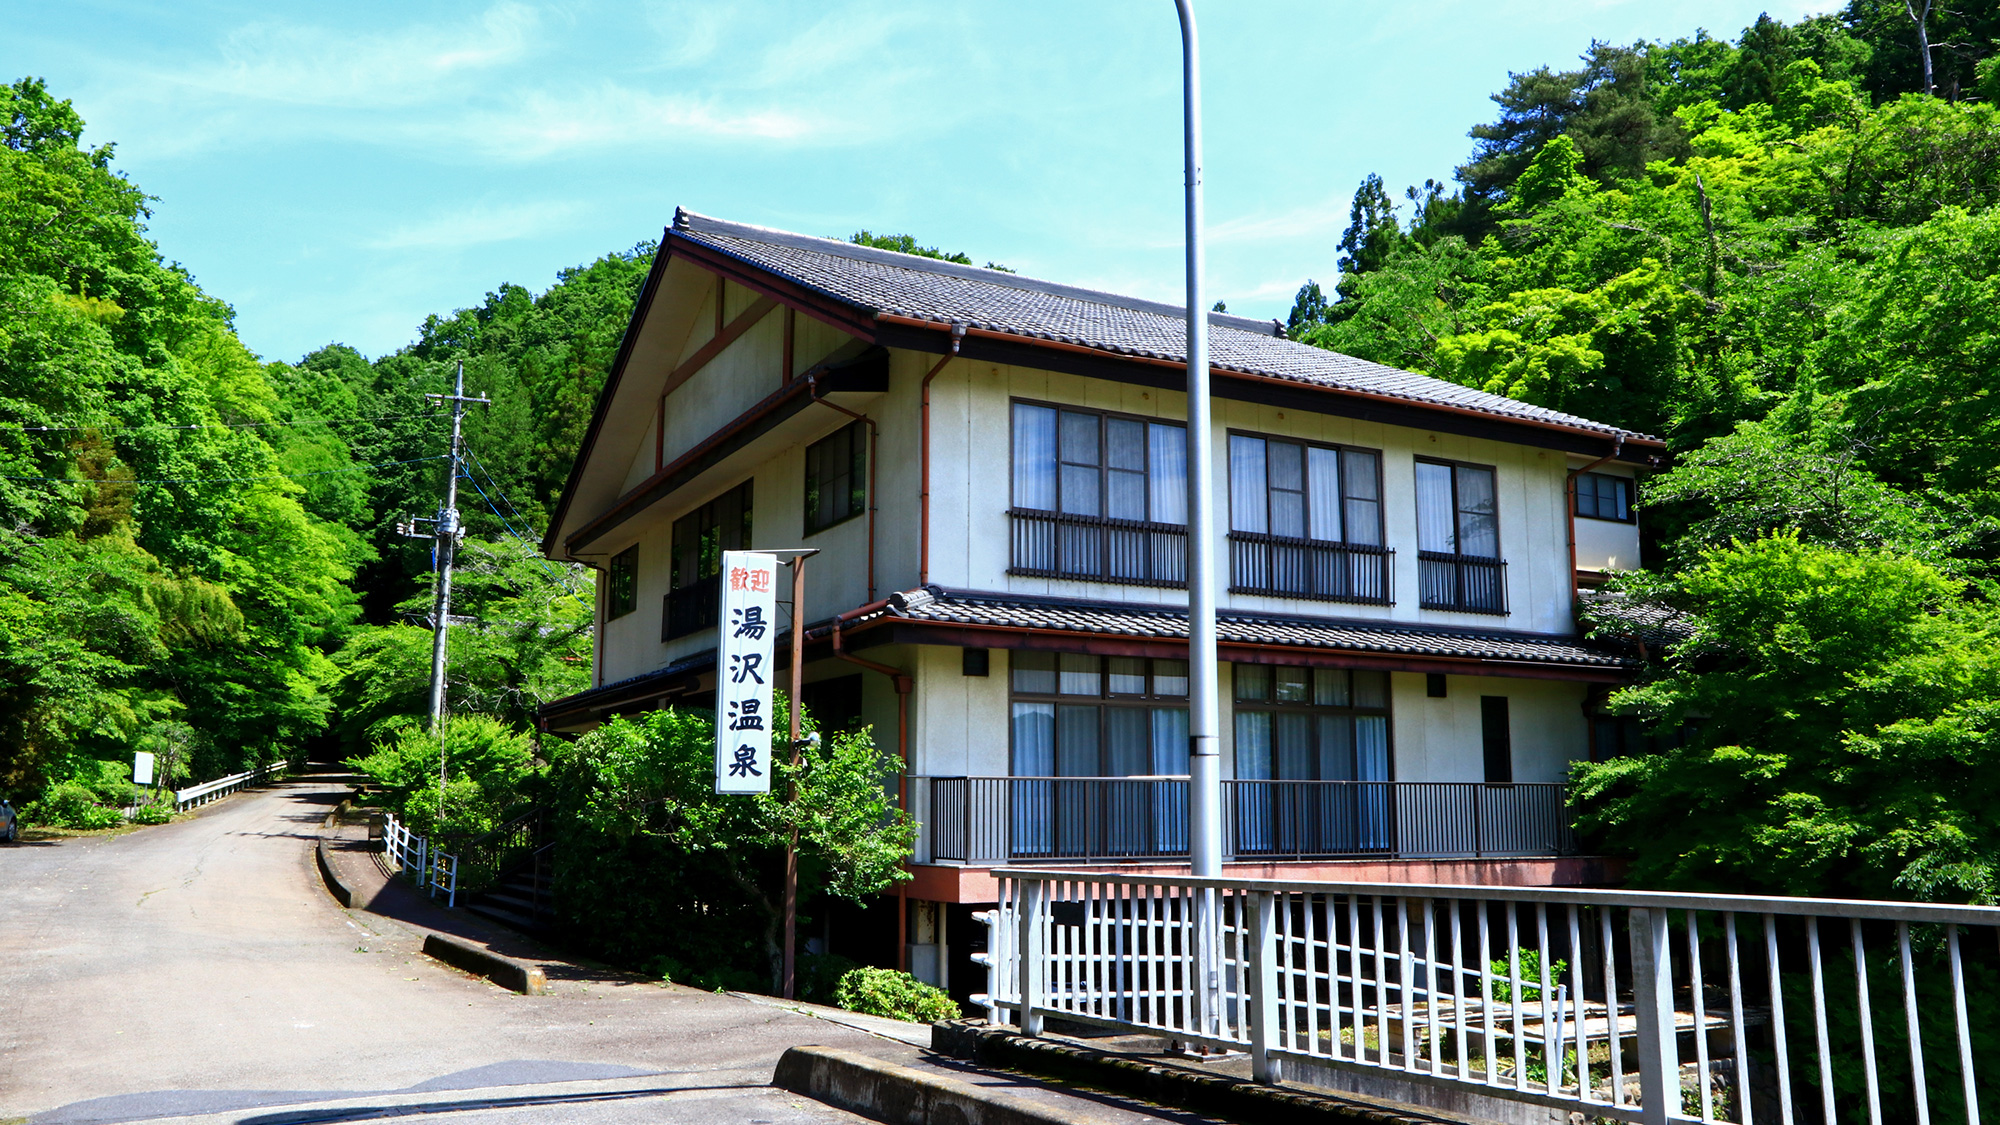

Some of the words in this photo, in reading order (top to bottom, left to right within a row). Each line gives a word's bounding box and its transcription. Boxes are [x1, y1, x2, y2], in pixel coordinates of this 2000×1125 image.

[730, 567, 770, 592] 歓迎
[728, 605, 767, 778] 湯沢温泉
